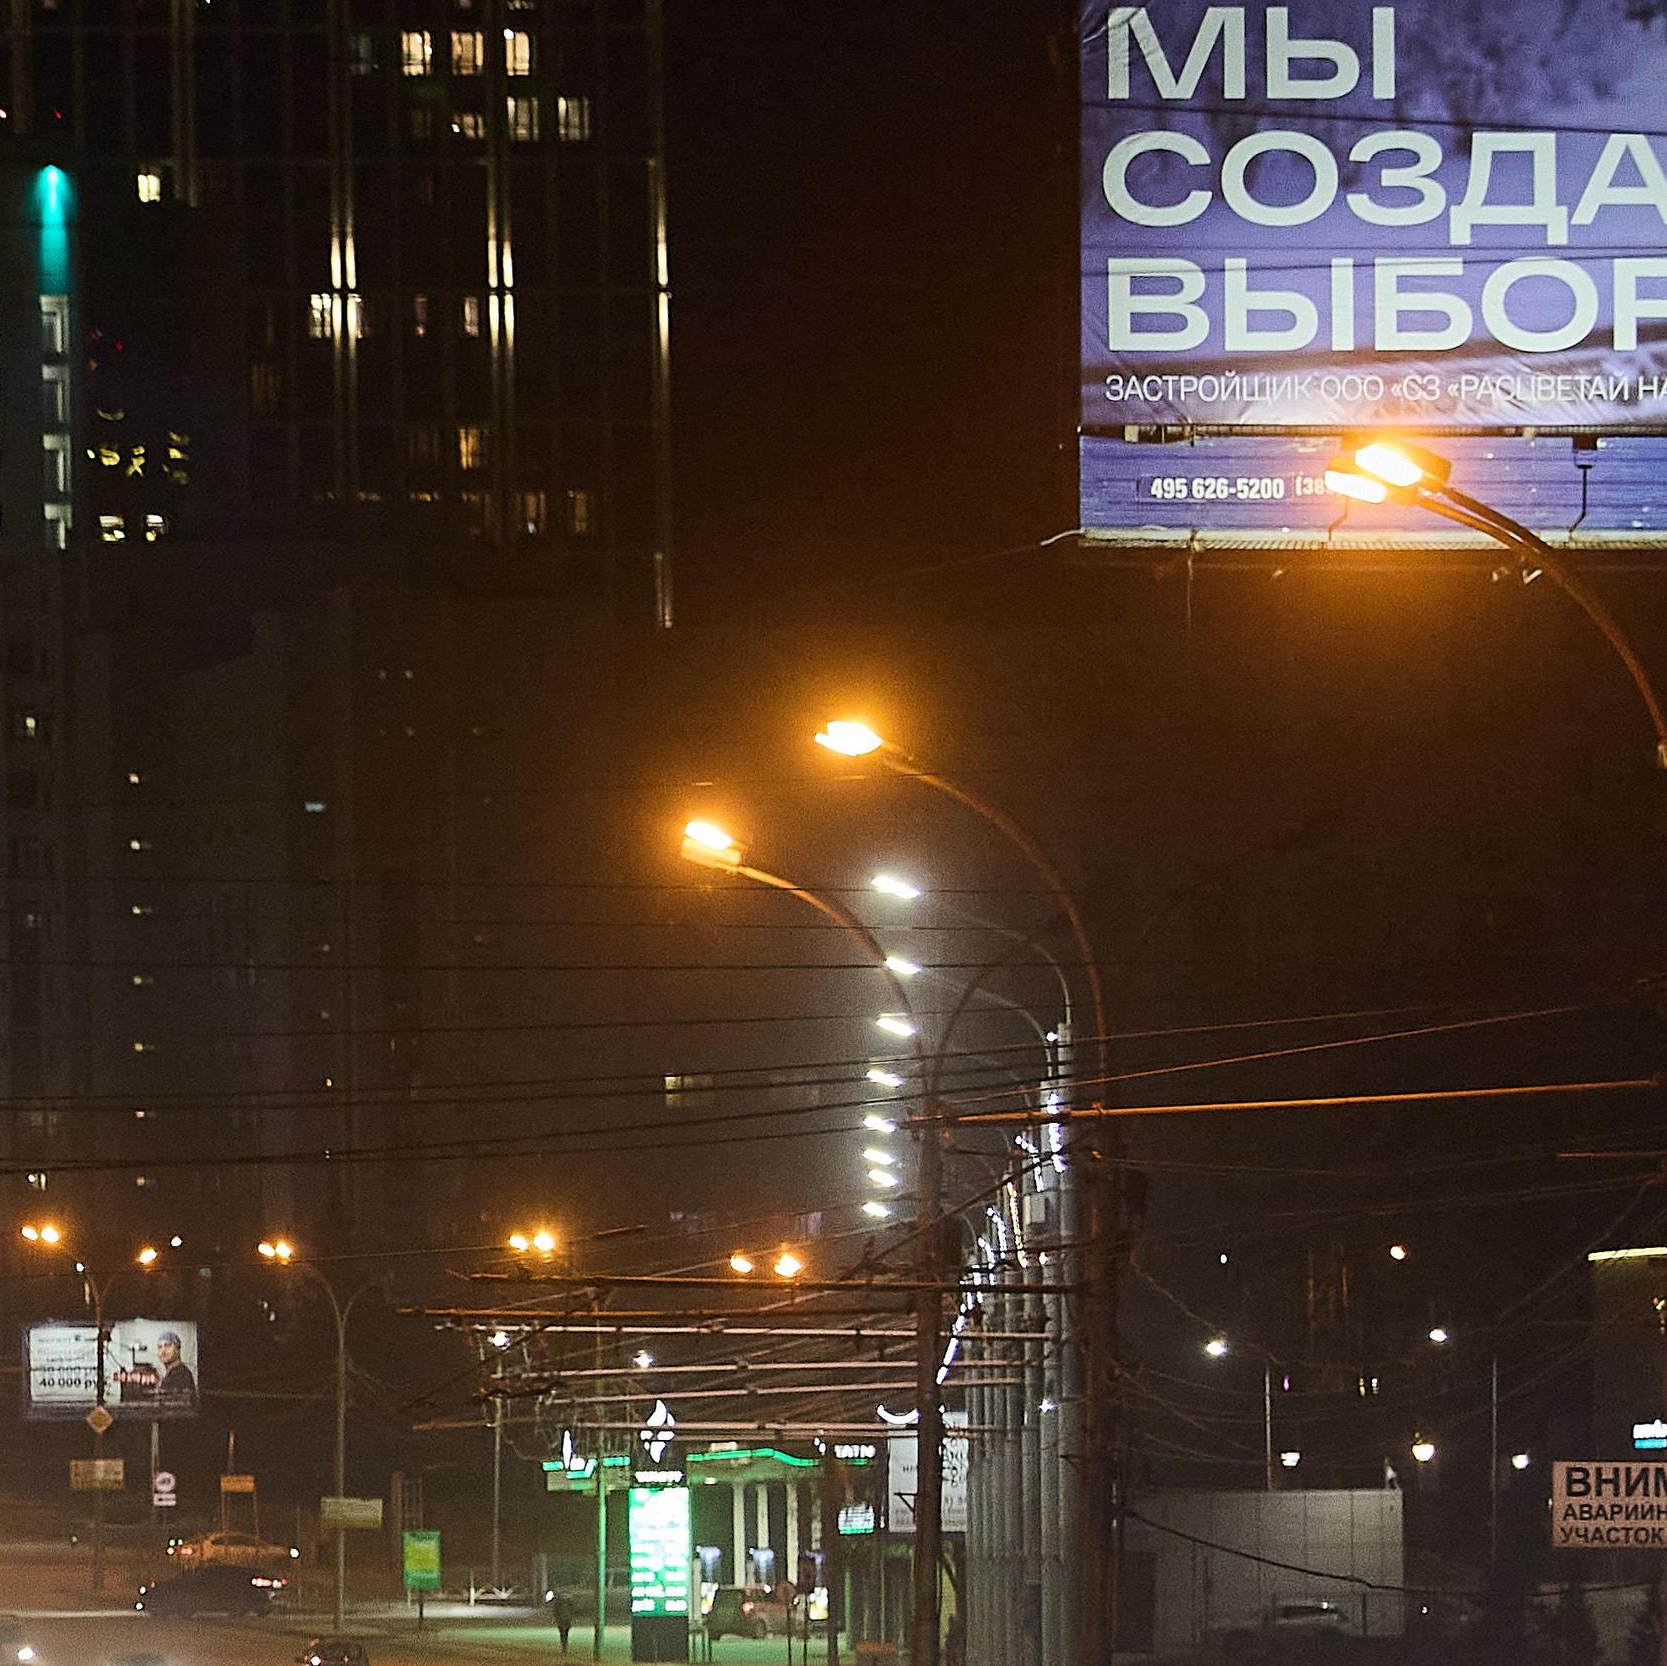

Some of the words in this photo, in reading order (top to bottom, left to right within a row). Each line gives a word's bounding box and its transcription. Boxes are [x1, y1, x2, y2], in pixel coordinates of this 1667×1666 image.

[1107, 6, 1396, 100] МЫ
[1102, 130, 1667, 245] СОЗДА
[1105, 370, 1312, 403] ЗАСТРОЙЩИК
[1320, 375, 1384, 402] ООО
[1447, 370, 1629, 402] «РАСЦВЕТАЙ
[1150, 477, 1188, 500] 495
[1192, 477, 1285, 500] 626-5200
[1295, 475, 1334, 497] (38
[1560, 1526, 1664, 1545] УЧАСТОК
